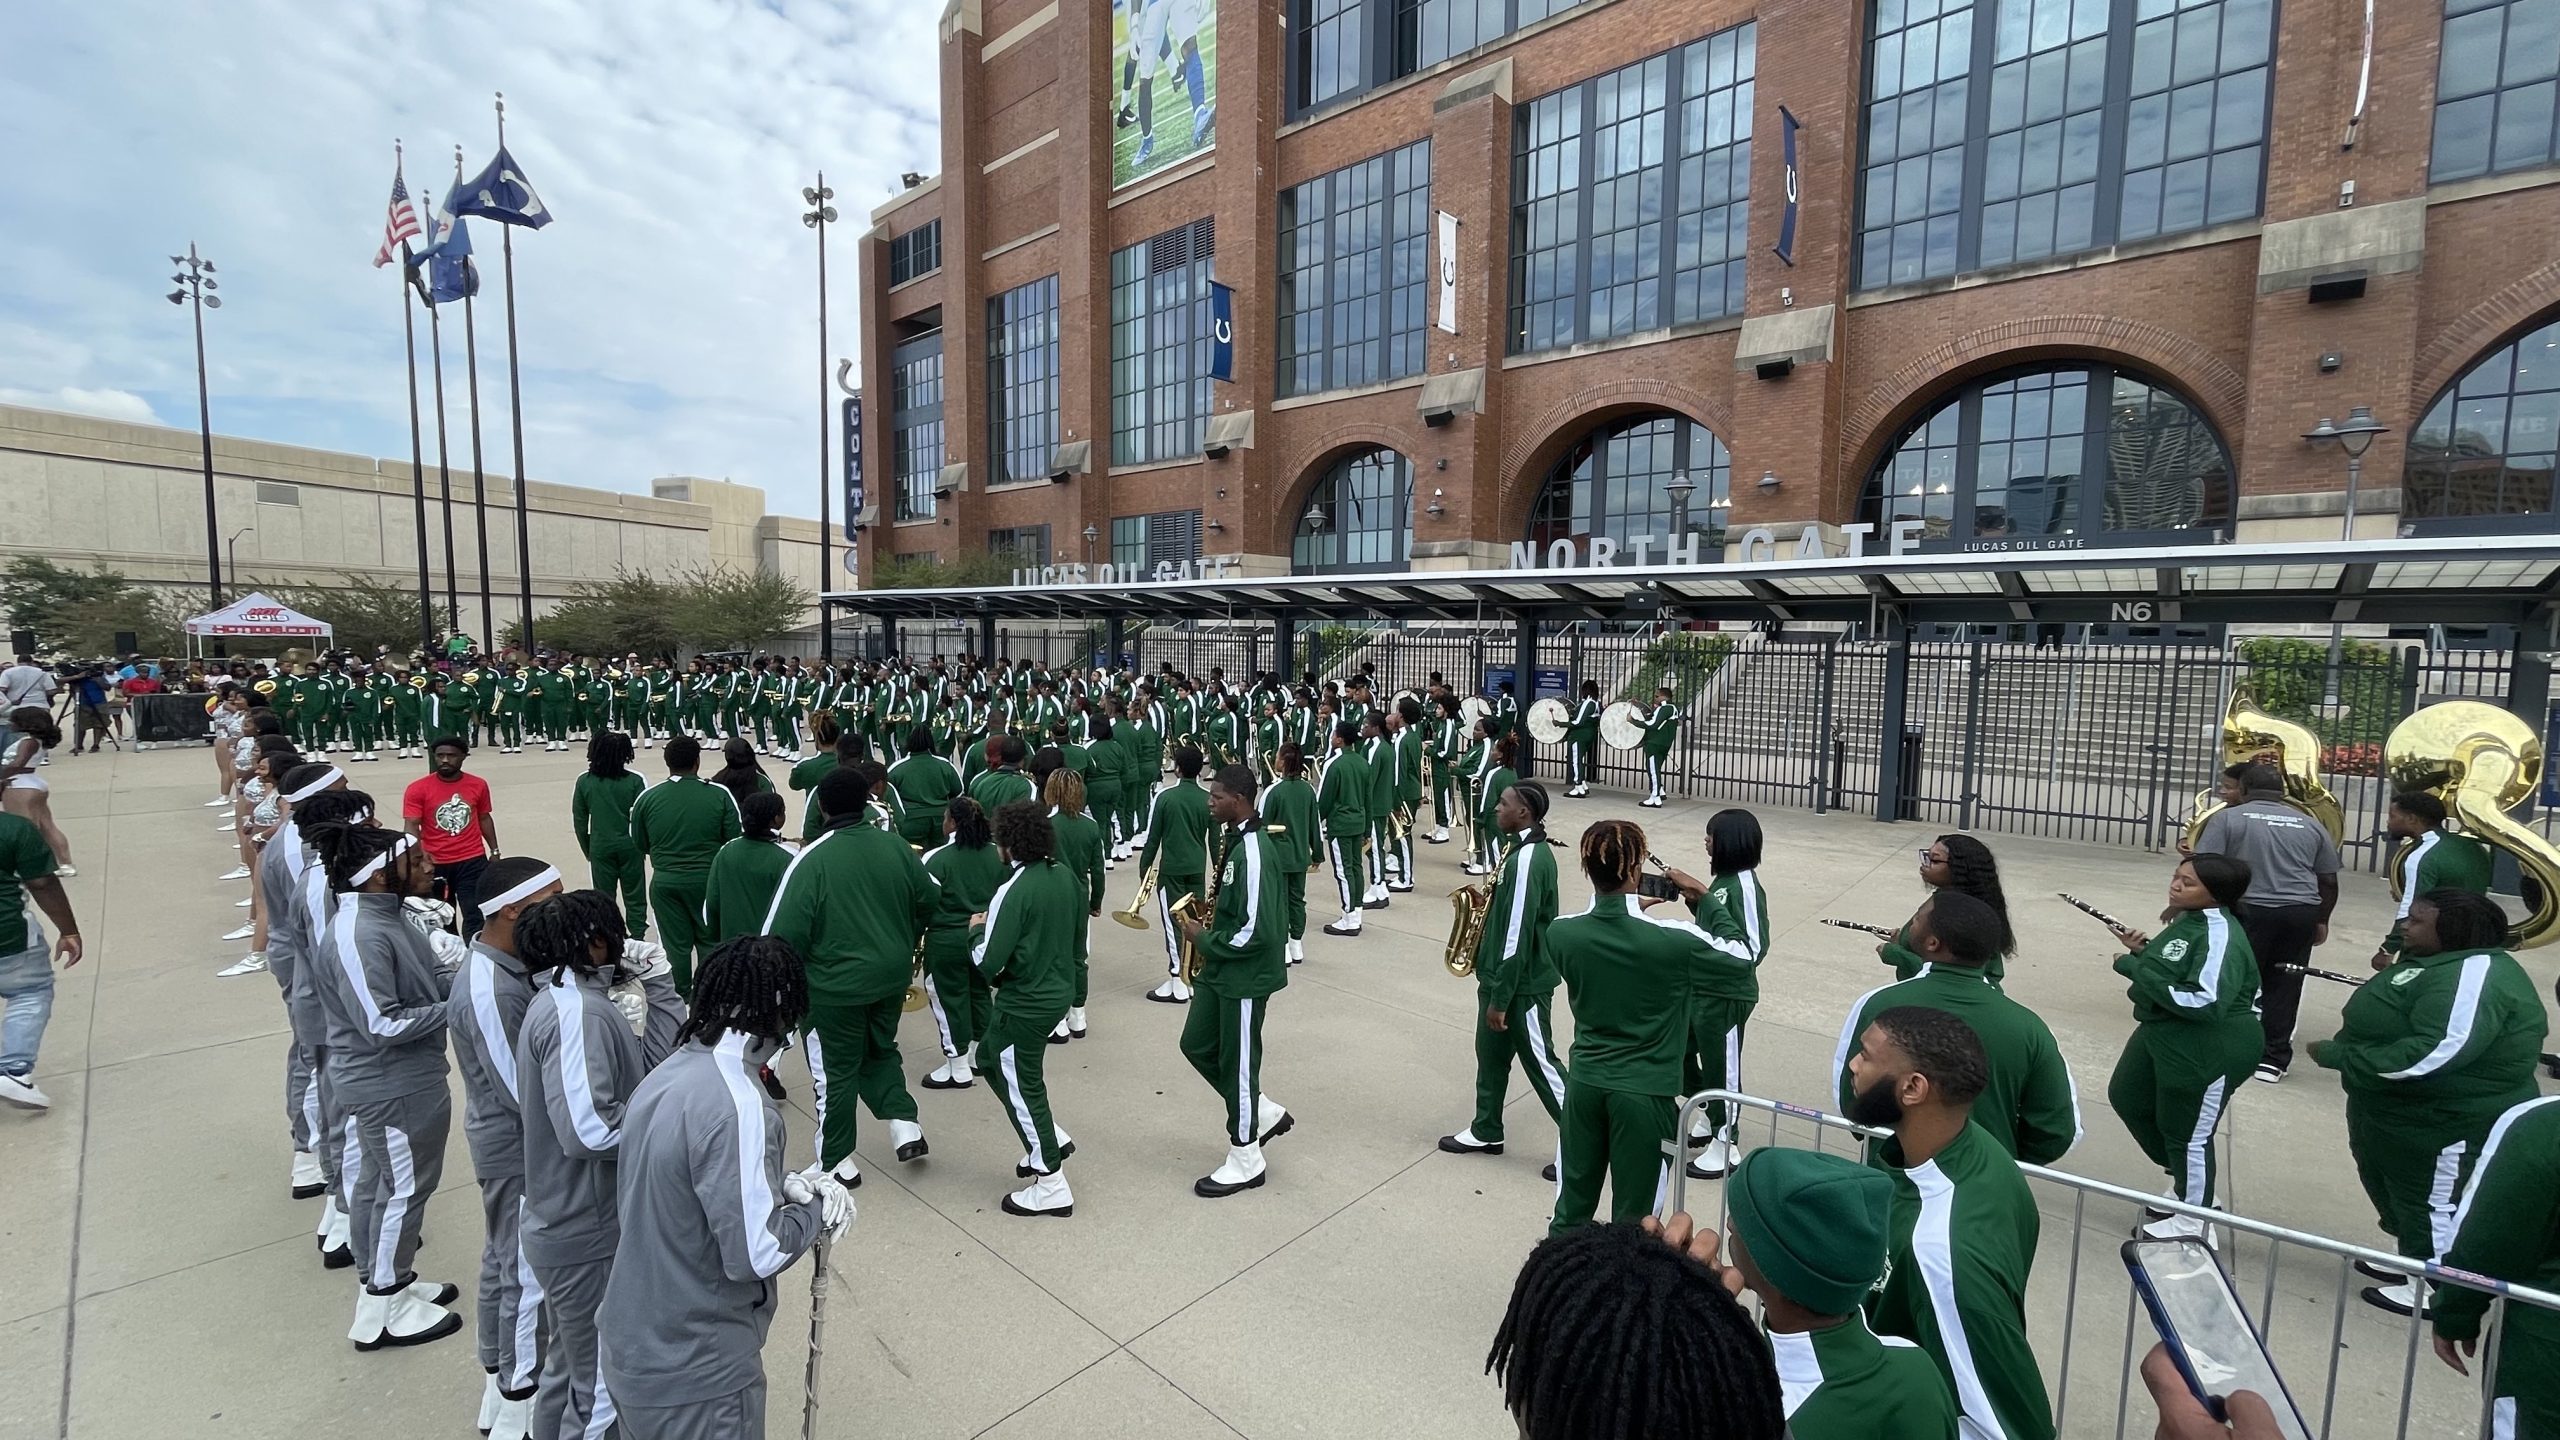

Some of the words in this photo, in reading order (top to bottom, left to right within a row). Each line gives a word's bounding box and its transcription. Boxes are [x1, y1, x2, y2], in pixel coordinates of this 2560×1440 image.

[1510, 532, 1699, 569] NORTH
[1740, 520, 1926, 563] GATE
[1964, 541, 2008, 552] LUCAS
[2016, 540, 2039, 551] OIL
[2047, 538, 2086, 550] GATE
[1012, 562, 1087, 586] LUCAS
[1100, 562, 1138, 583] OIL
[1155, 558, 1230, 583] GATE
[2111, 601, 2152, 621] N6
